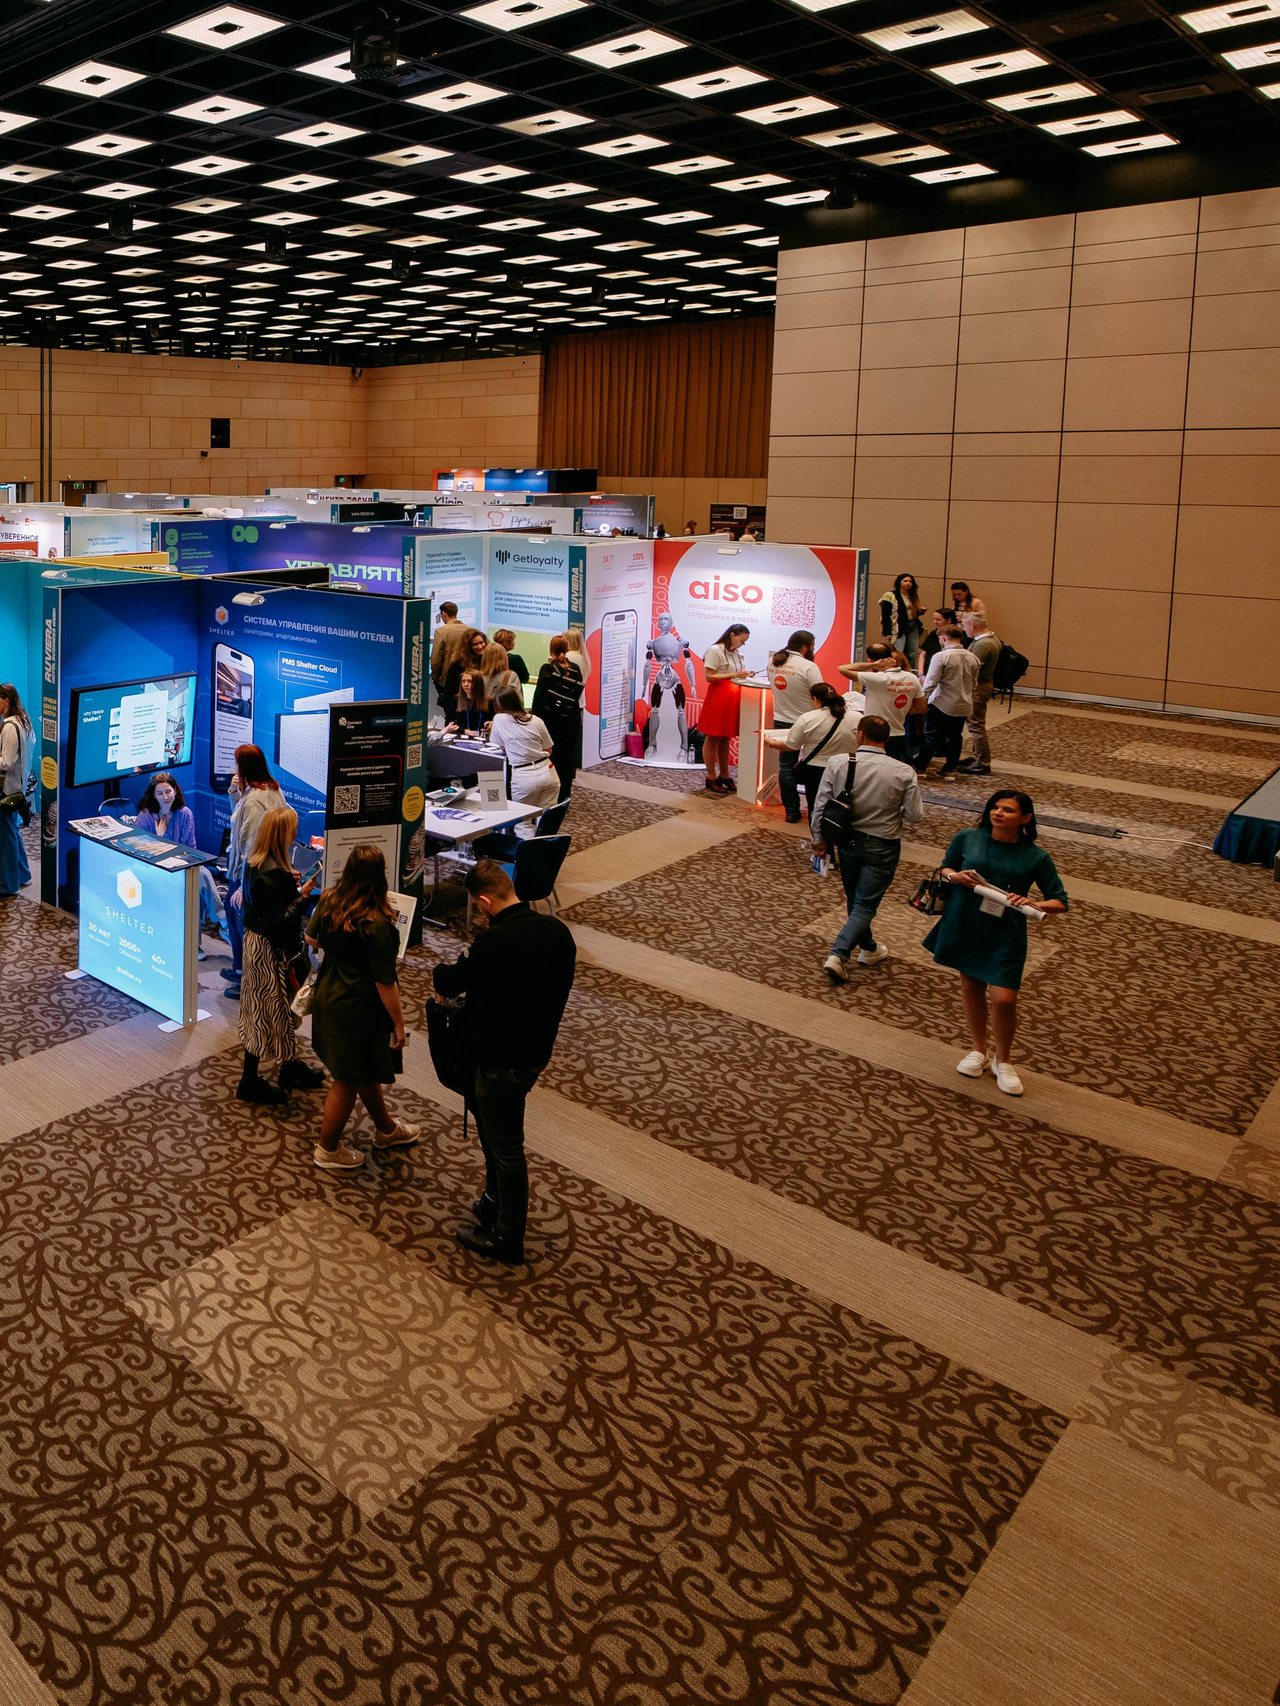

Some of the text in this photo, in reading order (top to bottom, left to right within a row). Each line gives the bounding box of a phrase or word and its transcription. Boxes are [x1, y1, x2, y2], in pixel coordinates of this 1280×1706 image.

[513, 554, 564, 568] Getloyalty
[602, 552, 644, 564] 24/7 100%
[494, 590, 563, 602] Инновационная платформа
[571, 567, 579, 613] RUVIERA
[688, 575, 763, 604] aiso
[509, 609, 550, 617] взаимодействия
[687, 603, 751, 614] который заменит
[687, 612, 730, 620] сотрудника
[209, 626, 235, 636] SHELTER
[243, 615, 394, 644] СИСТЕМА УПРАВЛЕНИЯ ВАШИМ ОТЕЛЕМ
[243, 627, 318, 644] санаторием, апартаментами
[44, 618, 52, 683] RUVIERA
[282, 657, 338, 674] PMS Shelter Cloud
[410, 635, 420, 705] RUVIERA
[294, 792, 326, 809] Shelter Pro
[105, 906, 154, 936] SHELTER
[88, 922, 111, 939] 30 лет
[119, 937, 141, 953] 2000+
[151, 954, 166, 965] 40+
[116, 966, 142, 984] shelter.ru
